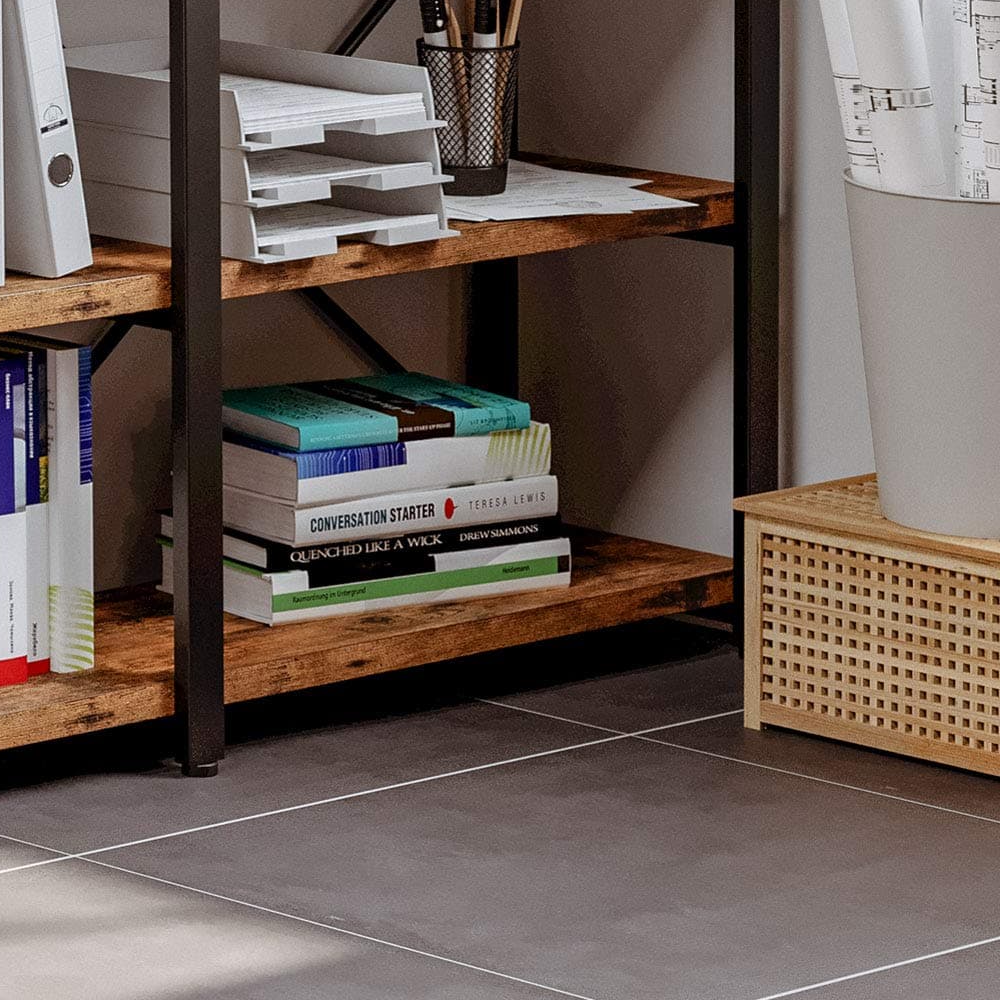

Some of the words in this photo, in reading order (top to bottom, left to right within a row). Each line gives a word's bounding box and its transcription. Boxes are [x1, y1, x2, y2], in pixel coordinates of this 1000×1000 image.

[310, 508, 387, 534] CONVERSATION
[390, 502, 435, 528] STARTER
[469, 495, 508, 511] TERESA
[514, 490, 547, 505] LEWIS
[290, 543, 362, 564] QUENCHED
[365, 541, 390, 554] LIKE
[392, 538, 404, 551] A
[406, 534, 443, 548] WICK
